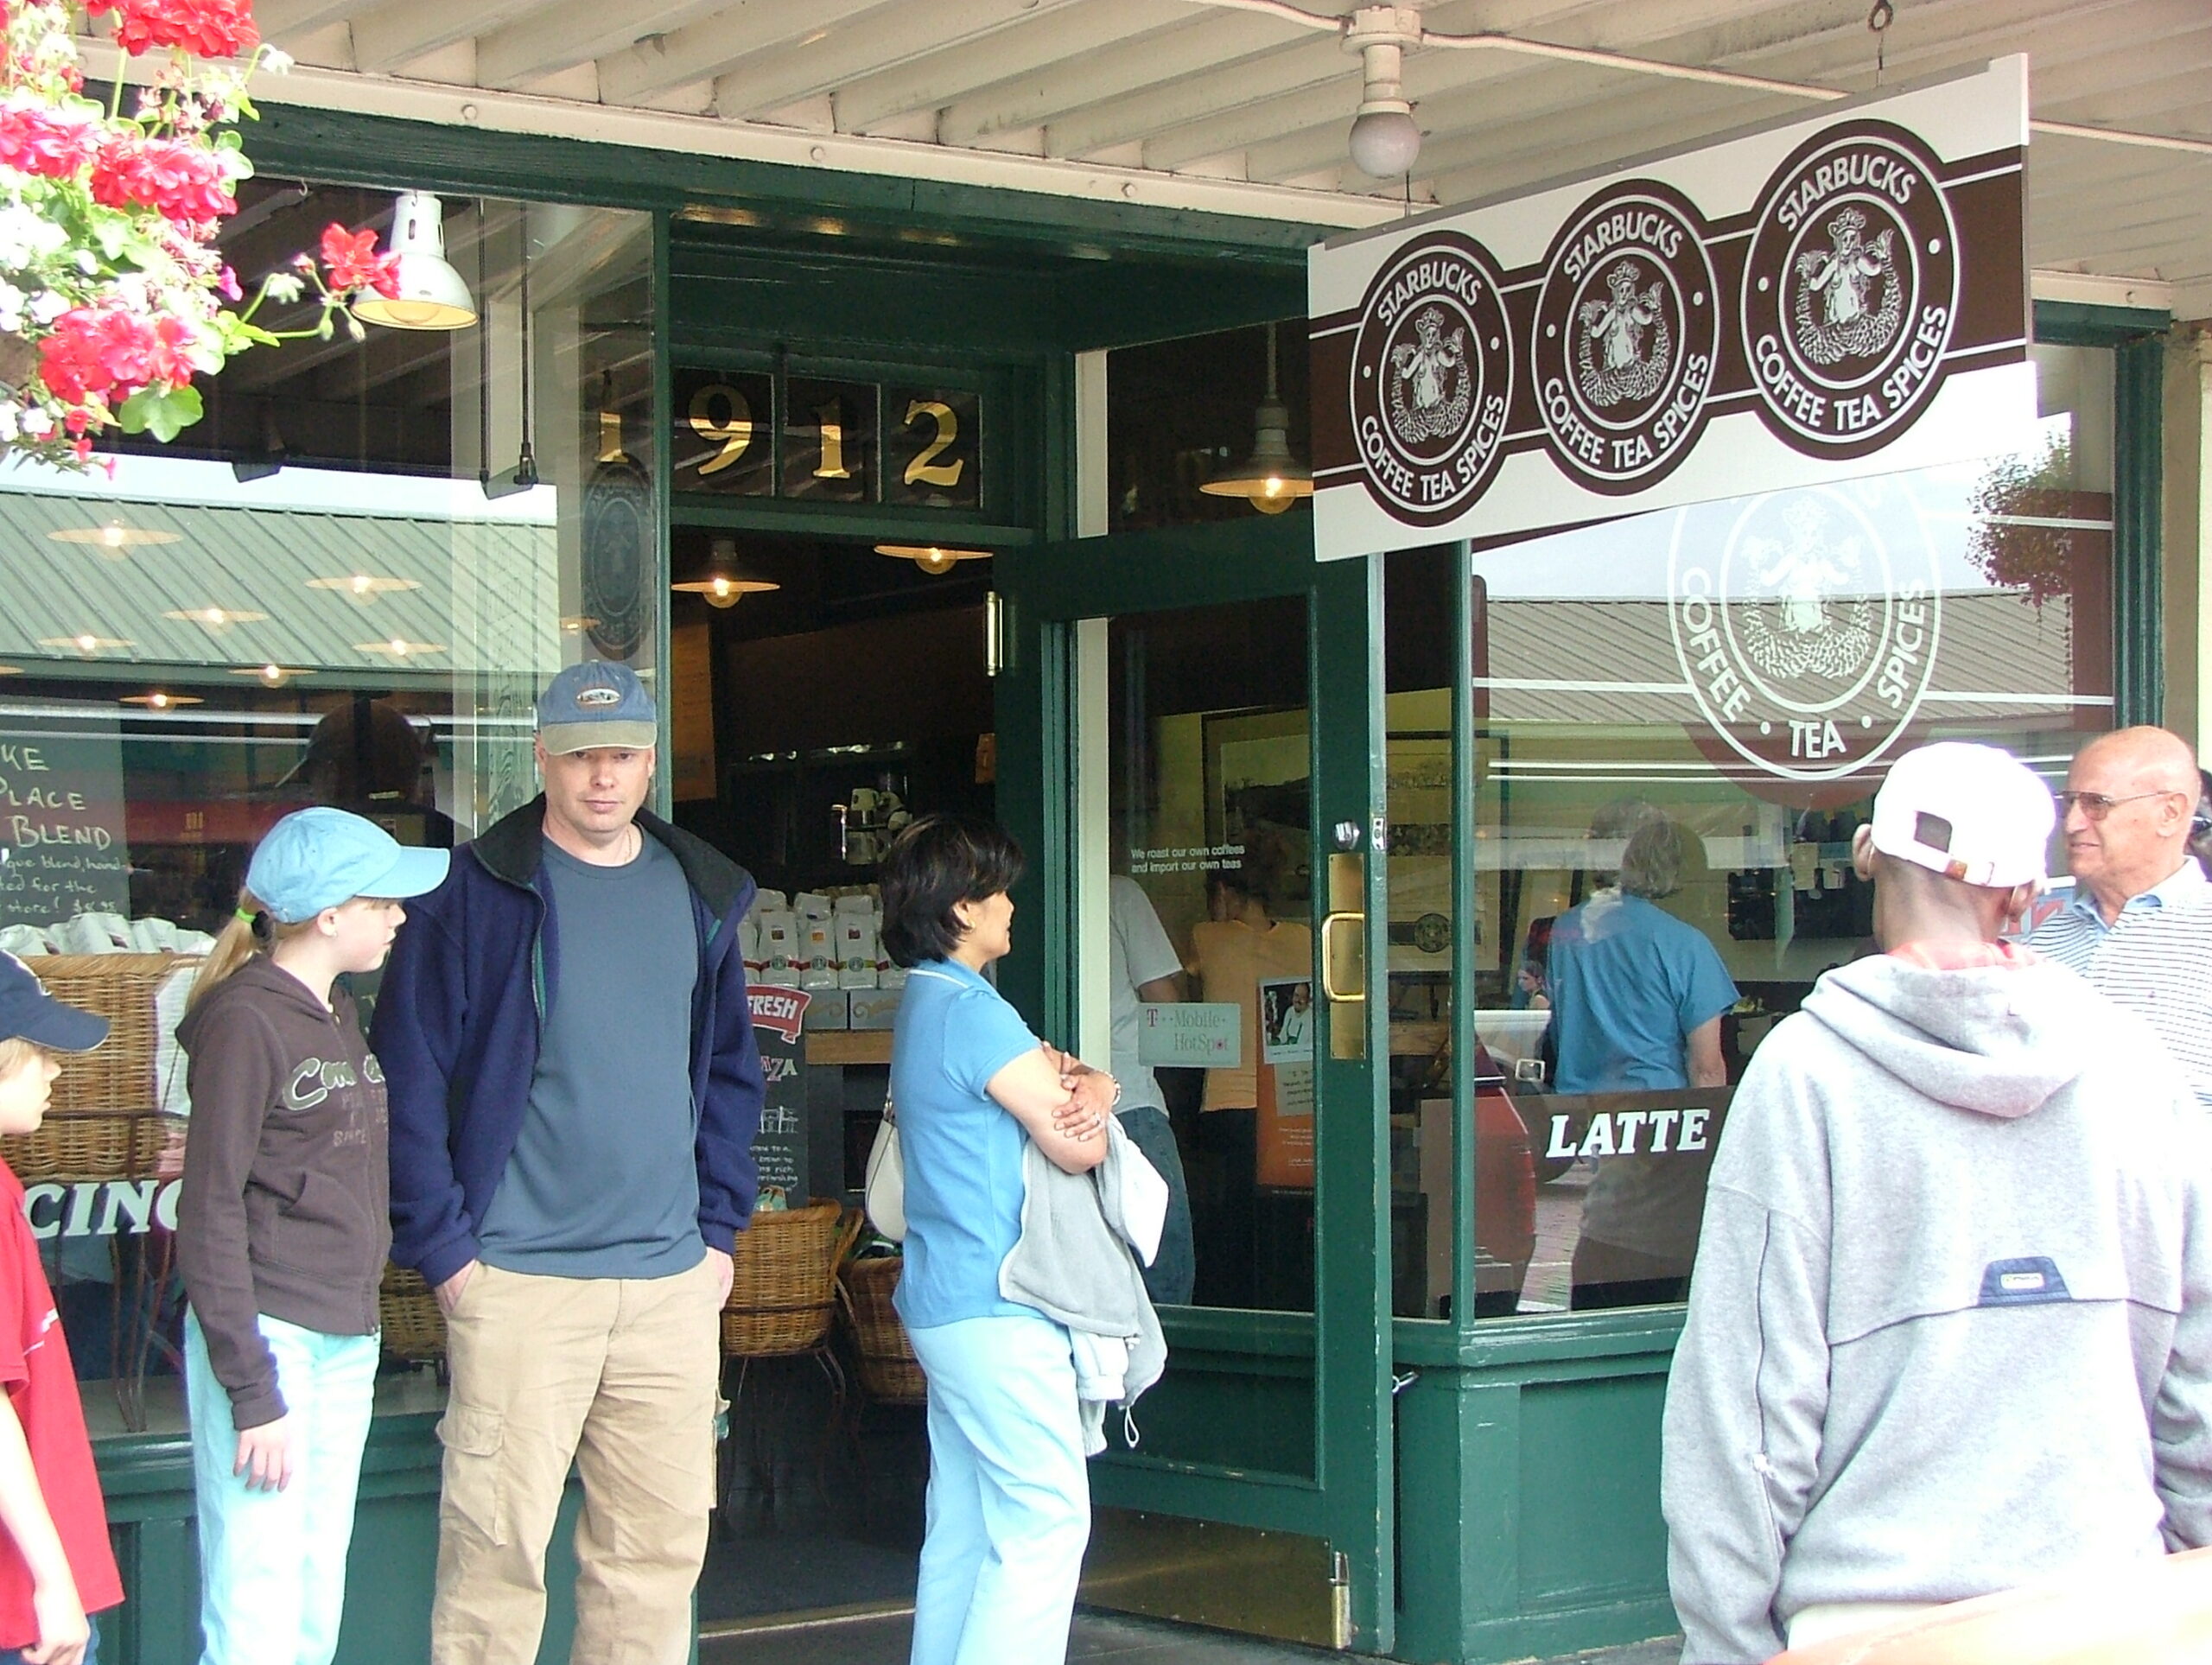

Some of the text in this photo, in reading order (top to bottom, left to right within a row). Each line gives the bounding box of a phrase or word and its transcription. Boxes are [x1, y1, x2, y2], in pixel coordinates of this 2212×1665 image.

[1777, 154, 1917, 232] STARBUCKS
[1563, 211, 1683, 283] STARBUCKS
[1376, 261, 1482, 327] STARBUCKS
[1756, 304, 1946, 431] COFFEE TEA SPICES
[1544, 353, 1708, 468] COFFEE TEA SPICES
[1362, 394, 1504, 502] COFFEE TEA SPICES
[1681, 567, 1927, 759] COFFEE TEA SPICES
[5, 815, 111, 851] BLEND
[1131, 844, 1245, 859] We roast our own coffees
[32, 877, 60, 892] for
[65, 880, 97, 894] the
[1131, 859, 1242, 875] and import our own teas
[747, 995, 798, 1020] FRESH
[1545, 1109, 1711, 1159] LATTE
